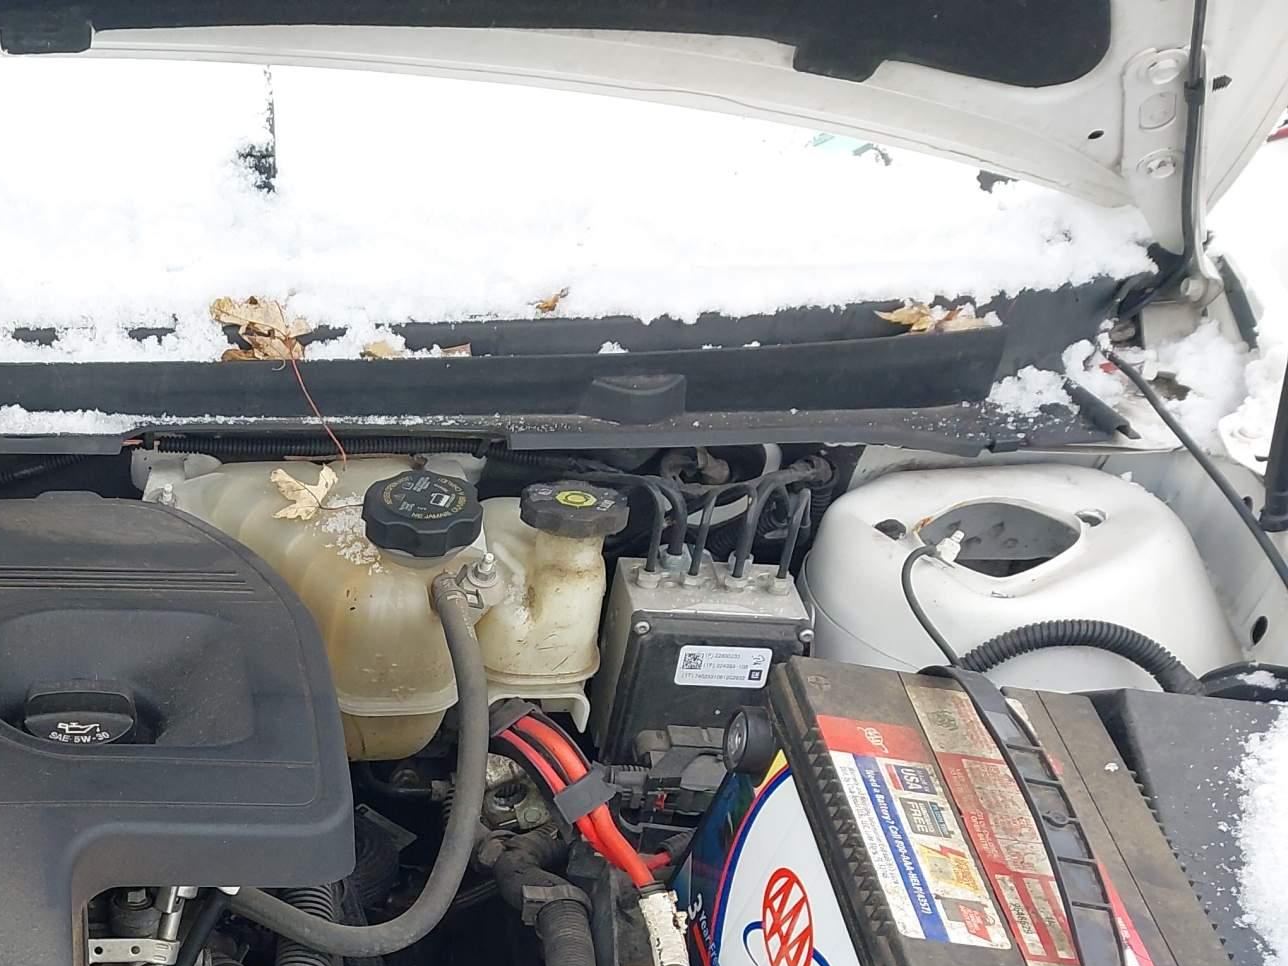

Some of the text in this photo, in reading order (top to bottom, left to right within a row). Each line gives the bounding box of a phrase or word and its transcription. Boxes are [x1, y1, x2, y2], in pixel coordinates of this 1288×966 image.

[49, 732, 110, 743] SAE 5W-30
[900, 768, 923, 790] USA
[865, 769, 880, 788] Need
[875, 793, 894, 826] Battery?
[889, 826, 903, 842] Call
[906, 801, 928, 832] FREE
[688, 893, 702, 920] 3
[700, 910, 712, 942] Year
